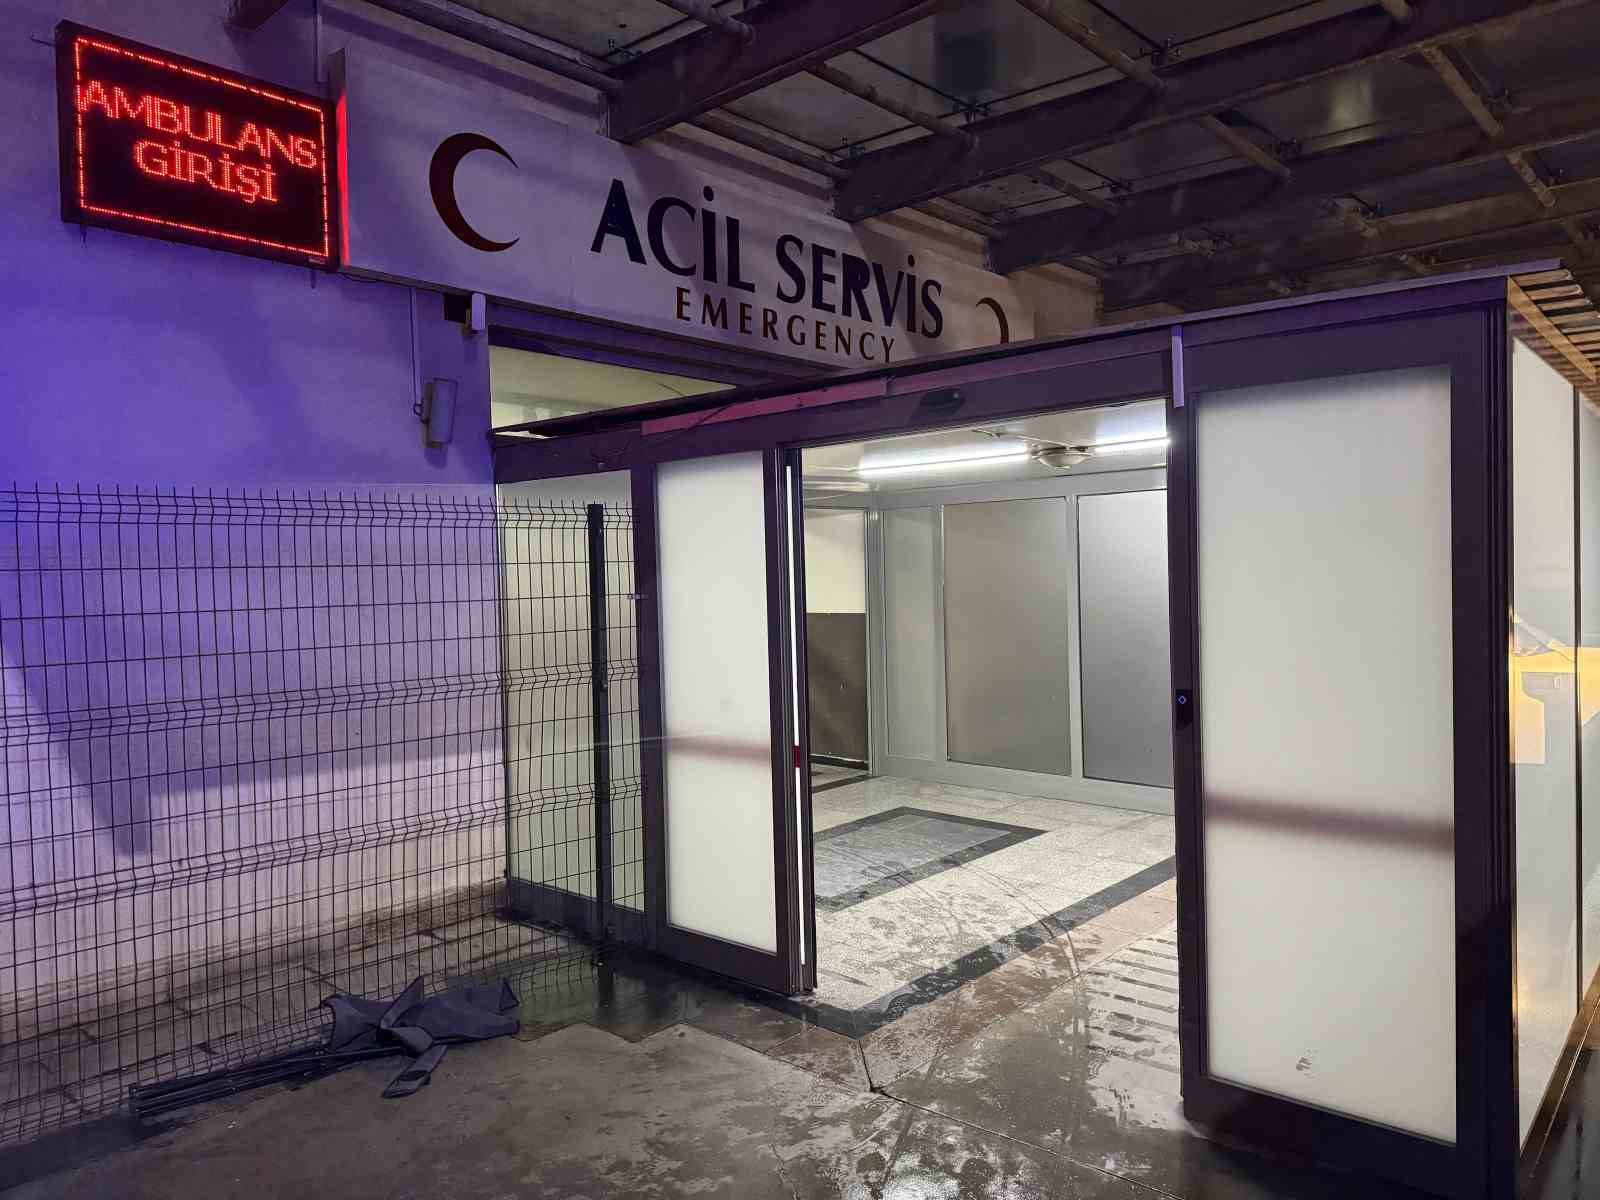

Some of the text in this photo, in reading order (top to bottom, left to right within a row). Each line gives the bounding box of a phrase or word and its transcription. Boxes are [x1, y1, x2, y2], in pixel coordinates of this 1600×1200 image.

[78, 79, 318, 169] AMBULANS
[134, 140, 278, 204] GİRİŞİ
[590, 178, 943, 339] ACİL SERVİS
[676, 286, 897, 364] EMERGENCY
